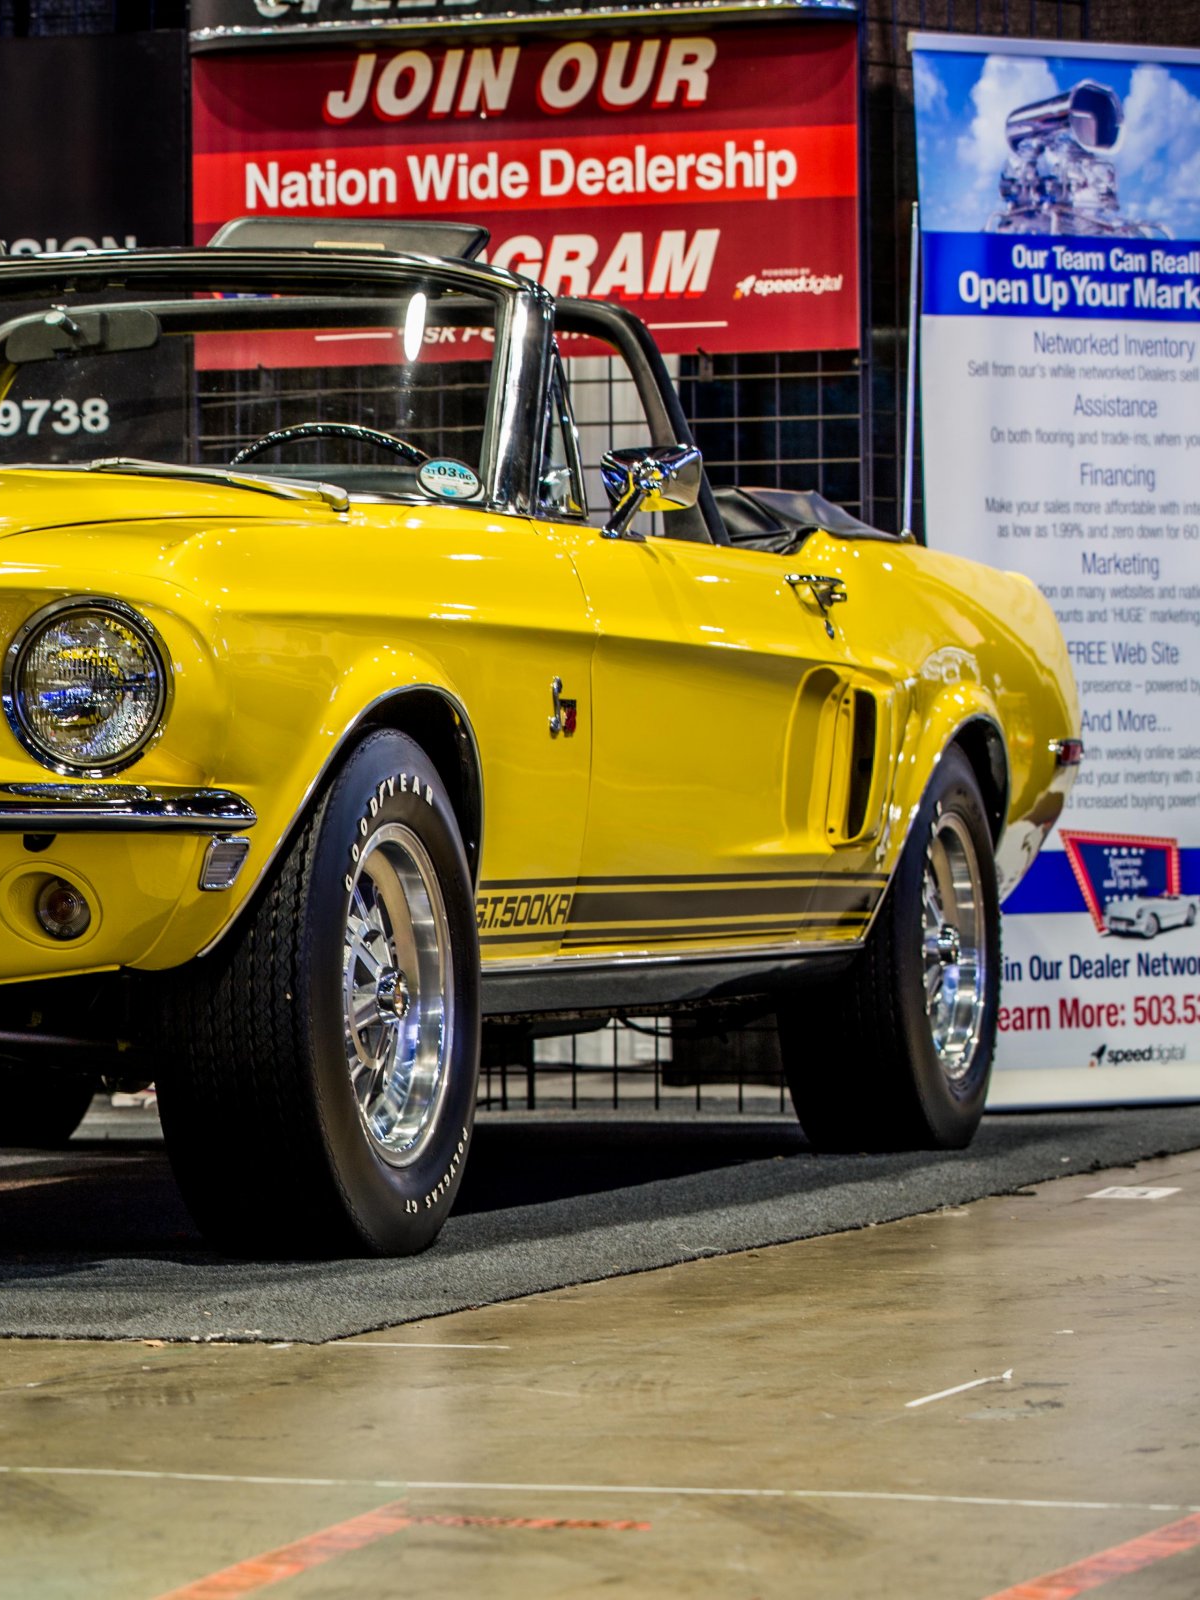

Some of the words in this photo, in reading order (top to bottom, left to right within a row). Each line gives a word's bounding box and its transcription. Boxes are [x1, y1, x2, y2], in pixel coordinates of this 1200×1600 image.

[326, 46, 520, 121] JOIN
[539, 37, 718, 114] OUR
[245, 159, 397, 209] Nation
[407, 151, 529, 202] Wide
[540, 139, 798, 200] Dealership
[474, 227, 721, 300] GRAM
[1012, 244, 1048, 269] Our
[1052, 246, 1105, 272] Team
[1110, 248, 1147, 273] Can
[958, 270, 1028, 309] Open
[1033, 273, 1069, 311] Up
[1070, 275, 1130, 307] Your
[1033, 331, 1119, 357] Networked
[1124, 334, 1196, 364] Inventory
[968, 360, 990, 377] Sell
[992, 361, 1016, 378] from
[1049, 363, 1077, 379] while
[1079, 364, 1135, 381] networked
[1137, 365, 1177, 382] Dealers
[1179, 366, 1200, 382] sell
[1073, 393, 1158, 419] Assistance
[990, 426, 1005, 444] On
[1007, 427, 1032, 445] both
[1035, 428, 1075, 448] flooring
[1077, 429, 1098, 446] and
[1153, 431, 1182, 447] when
[437, 466, 456, 477] 03
[1080, 462, 1156, 493] Financing
[984, 496, 1012, 514] Make
[1015, 500, 1039, 517] your
[1043, 499, 1071, 514] sales
[1073, 501, 1100, 515] more
[1104, 498, 1156, 516] affordable
[1159, 499, 1180, 516] with
[1012, 523, 1031, 538] low
[1087, 523, 1108, 539] and
[1111, 526, 1134, 540] zero
[1137, 523, 1164, 539] down
[1166, 524, 1180, 539] for
[1081, 551, 1160, 581] Marketing
[1060, 586, 1074, 599] on
[1076, 586, 1105, 602] many
[1109, 584, 1154, 599] websites
[1157, 585, 1176, 599] and
[1086, 608, 1108, 623] and
[1066, 641, 1107, 665] FREE
[1111, 642, 1147, 665] Web
[1151, 641, 1179, 665] Site
[1082, 680, 1132, 695] presence
[1145, 679, 1188, 695] powered
[1081, 709, 1112, 733] And
[1106, 745, 1141, 763] weekly
[1144, 745, 1172, 760] online
[1097, 772, 1120, 787] your
[1123, 769, 1169, 786] inventory
[1076, 793, 1128, 809] increased
[1131, 793, 1165, 811] buying
[1029, 954, 1062, 982] Our
[1069, 953, 1130, 980] Dealer
[1058, 997, 1126, 1030] More:
